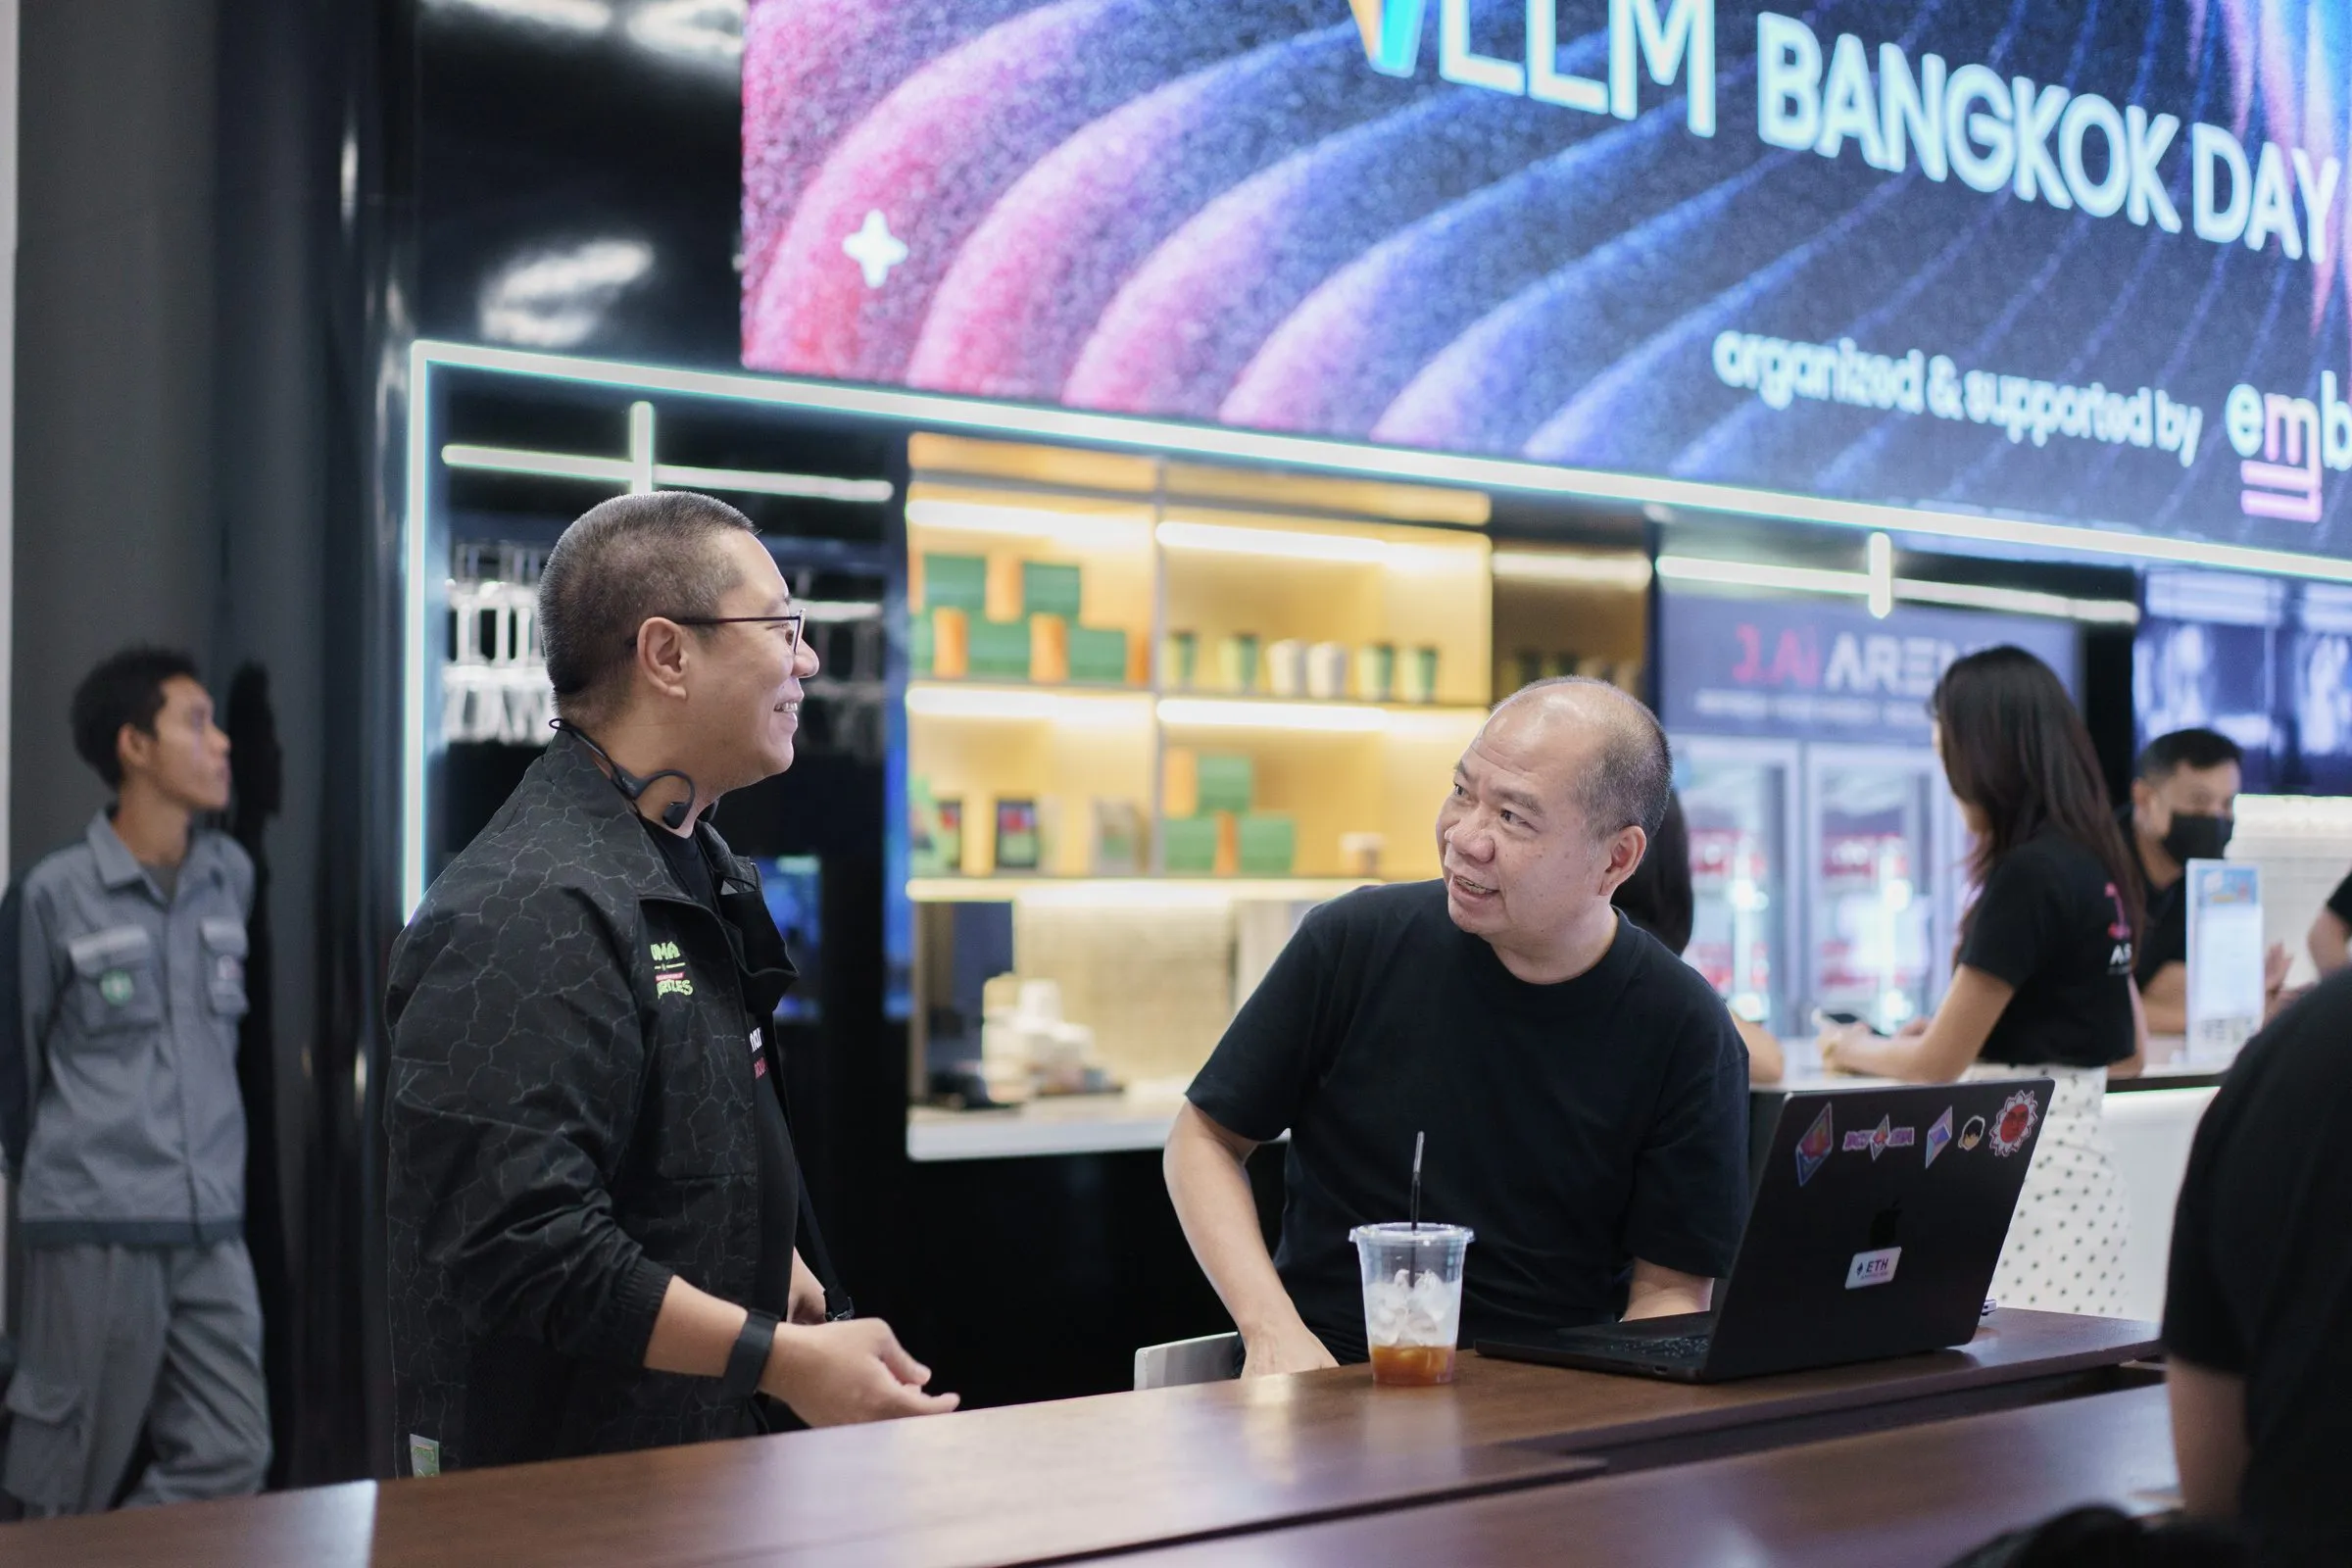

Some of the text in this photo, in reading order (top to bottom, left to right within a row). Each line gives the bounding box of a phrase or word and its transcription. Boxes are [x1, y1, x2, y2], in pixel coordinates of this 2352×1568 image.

[1757, 11, 2181, 234] BANGKOK
[2192, 122, 2341, 265] DAY
[1713, 330, 2203, 467] organized & supported by
[1866, 1257, 1889, 1273] ETH
